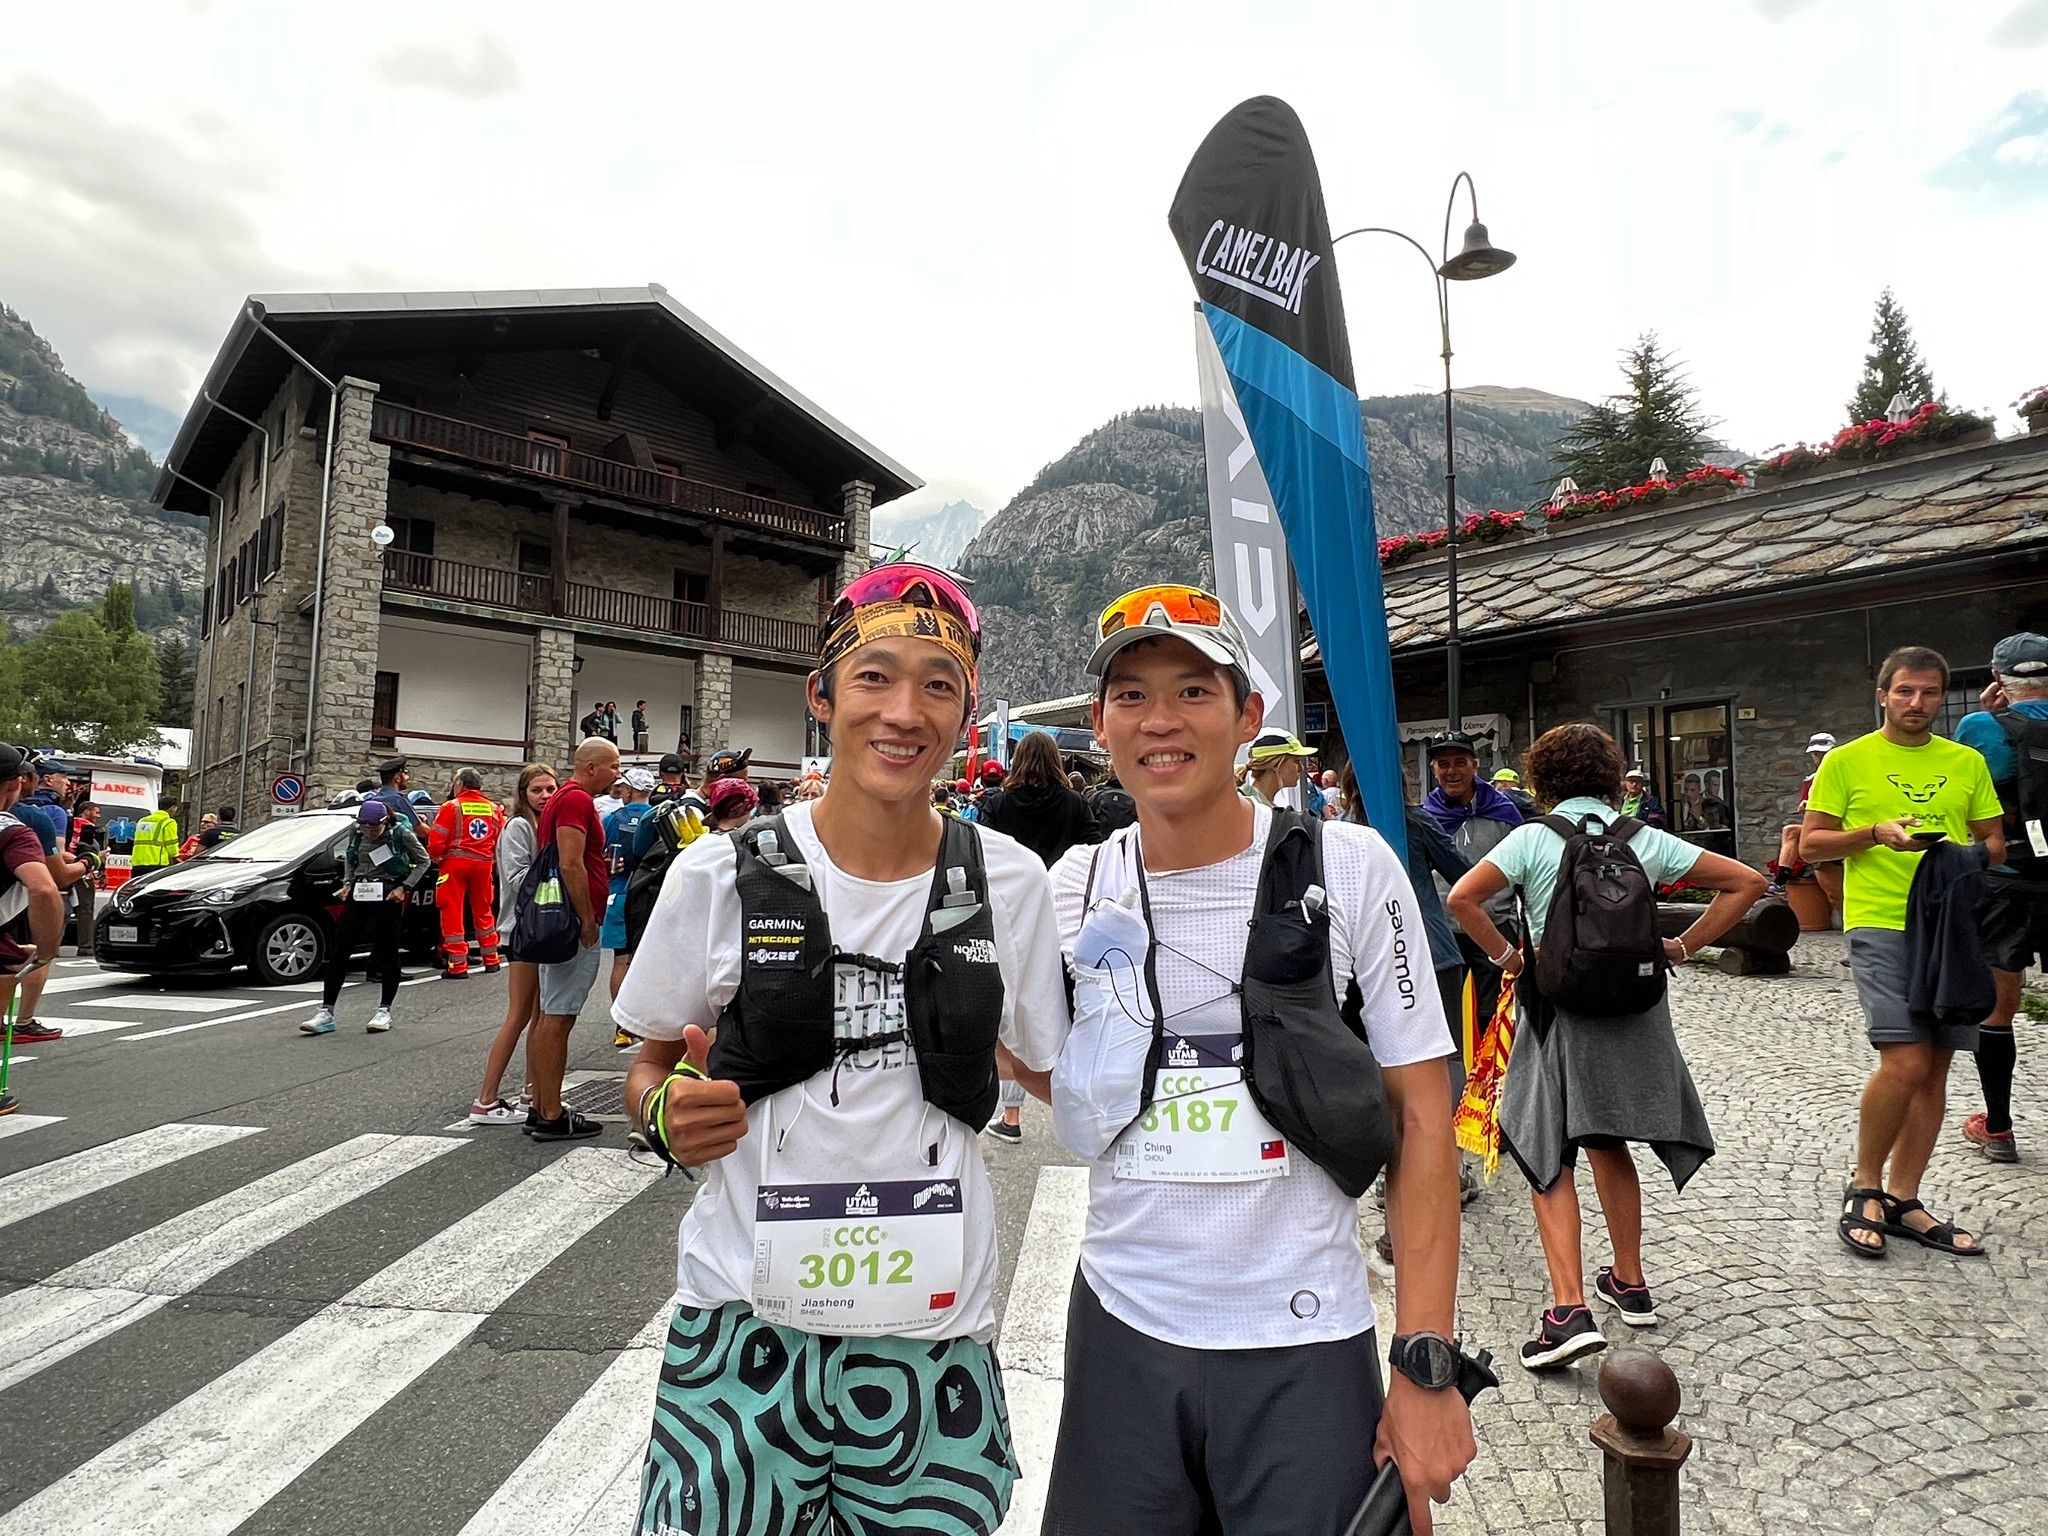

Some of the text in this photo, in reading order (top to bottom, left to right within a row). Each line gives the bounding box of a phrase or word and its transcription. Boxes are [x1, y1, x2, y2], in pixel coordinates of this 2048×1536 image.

[1196, 219, 1320, 315] CAMELBAK
[748, 919, 805, 930] GARMIN
[969, 938, 988, 948] THE
[953, 944, 989, 955] NORTH
[965, 953, 989, 963] FACE
[1167, 1049, 1199, 1059] UTMB
[1144, 1142, 1172, 1154] Ching
[845, 1196, 879, 1208] UTMB
[798, 1250, 914, 1289] 3012
[801, 1297, 855, 1309] Jiasheng
